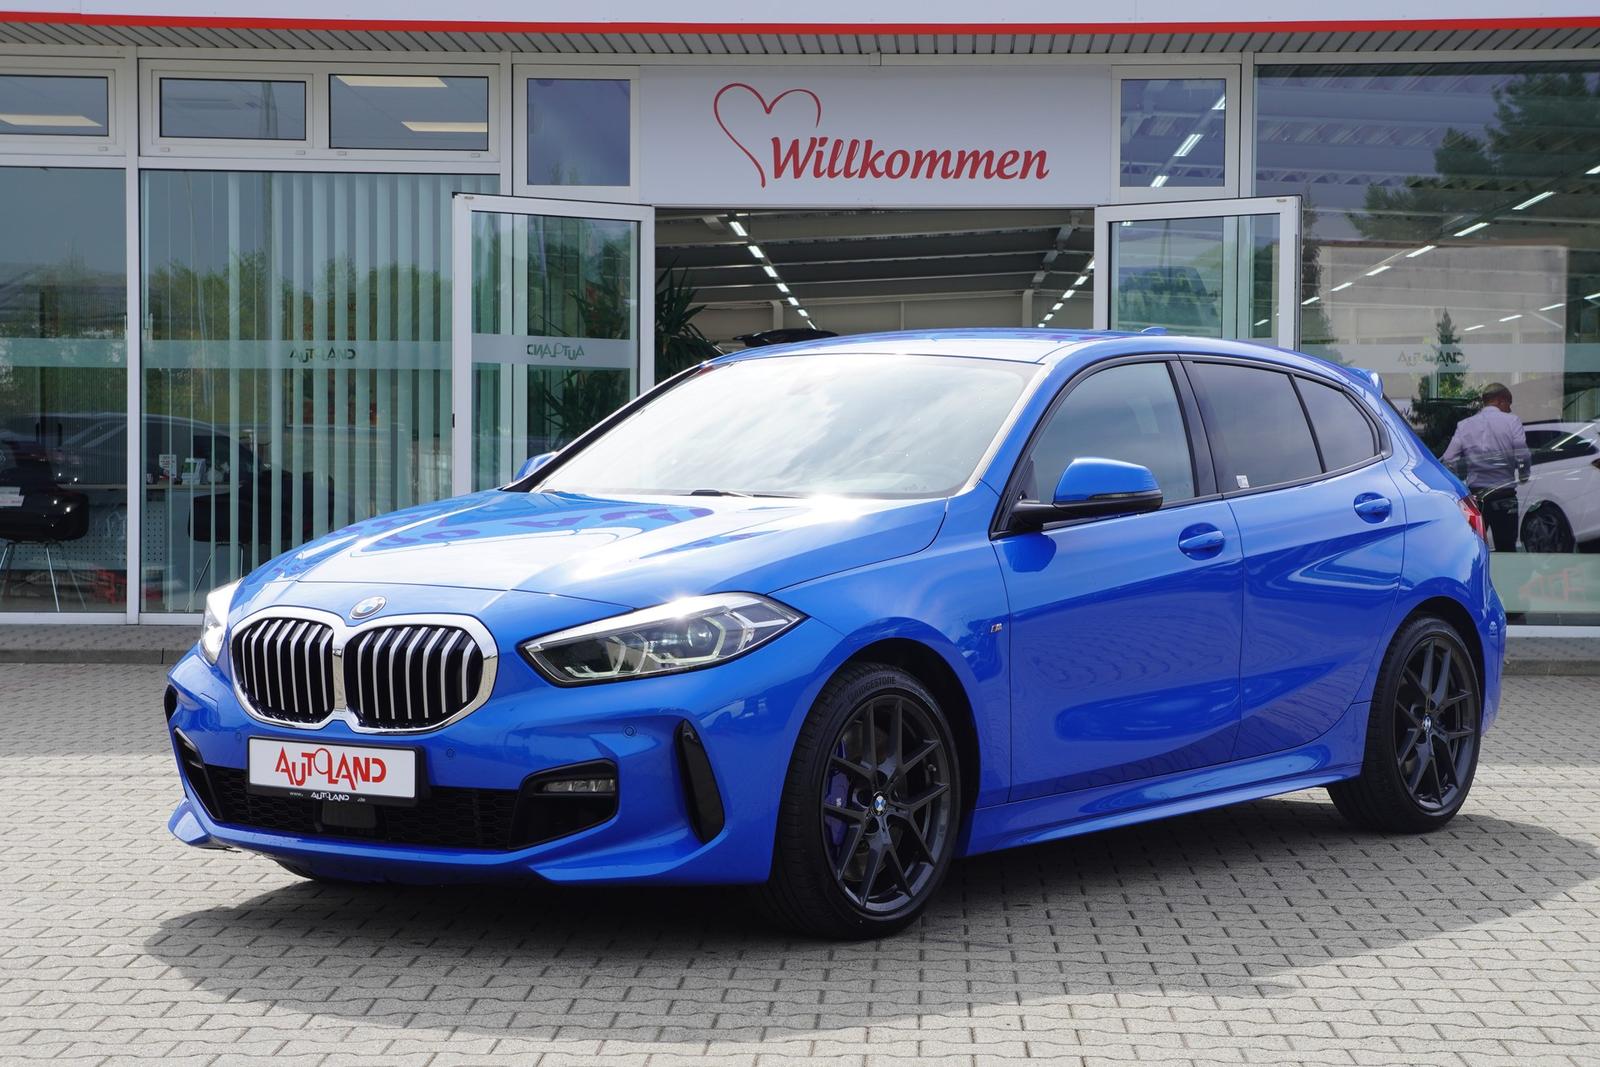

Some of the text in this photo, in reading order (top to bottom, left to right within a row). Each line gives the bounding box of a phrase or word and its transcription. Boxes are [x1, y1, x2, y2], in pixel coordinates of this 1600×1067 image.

[771, 137, 1050, 179] Willkommen
[289, 346, 356, 363] AUTLAND
[275, 746, 387, 790] AUTOLAND
[310, 791, 350, 802] AUTOLAND
